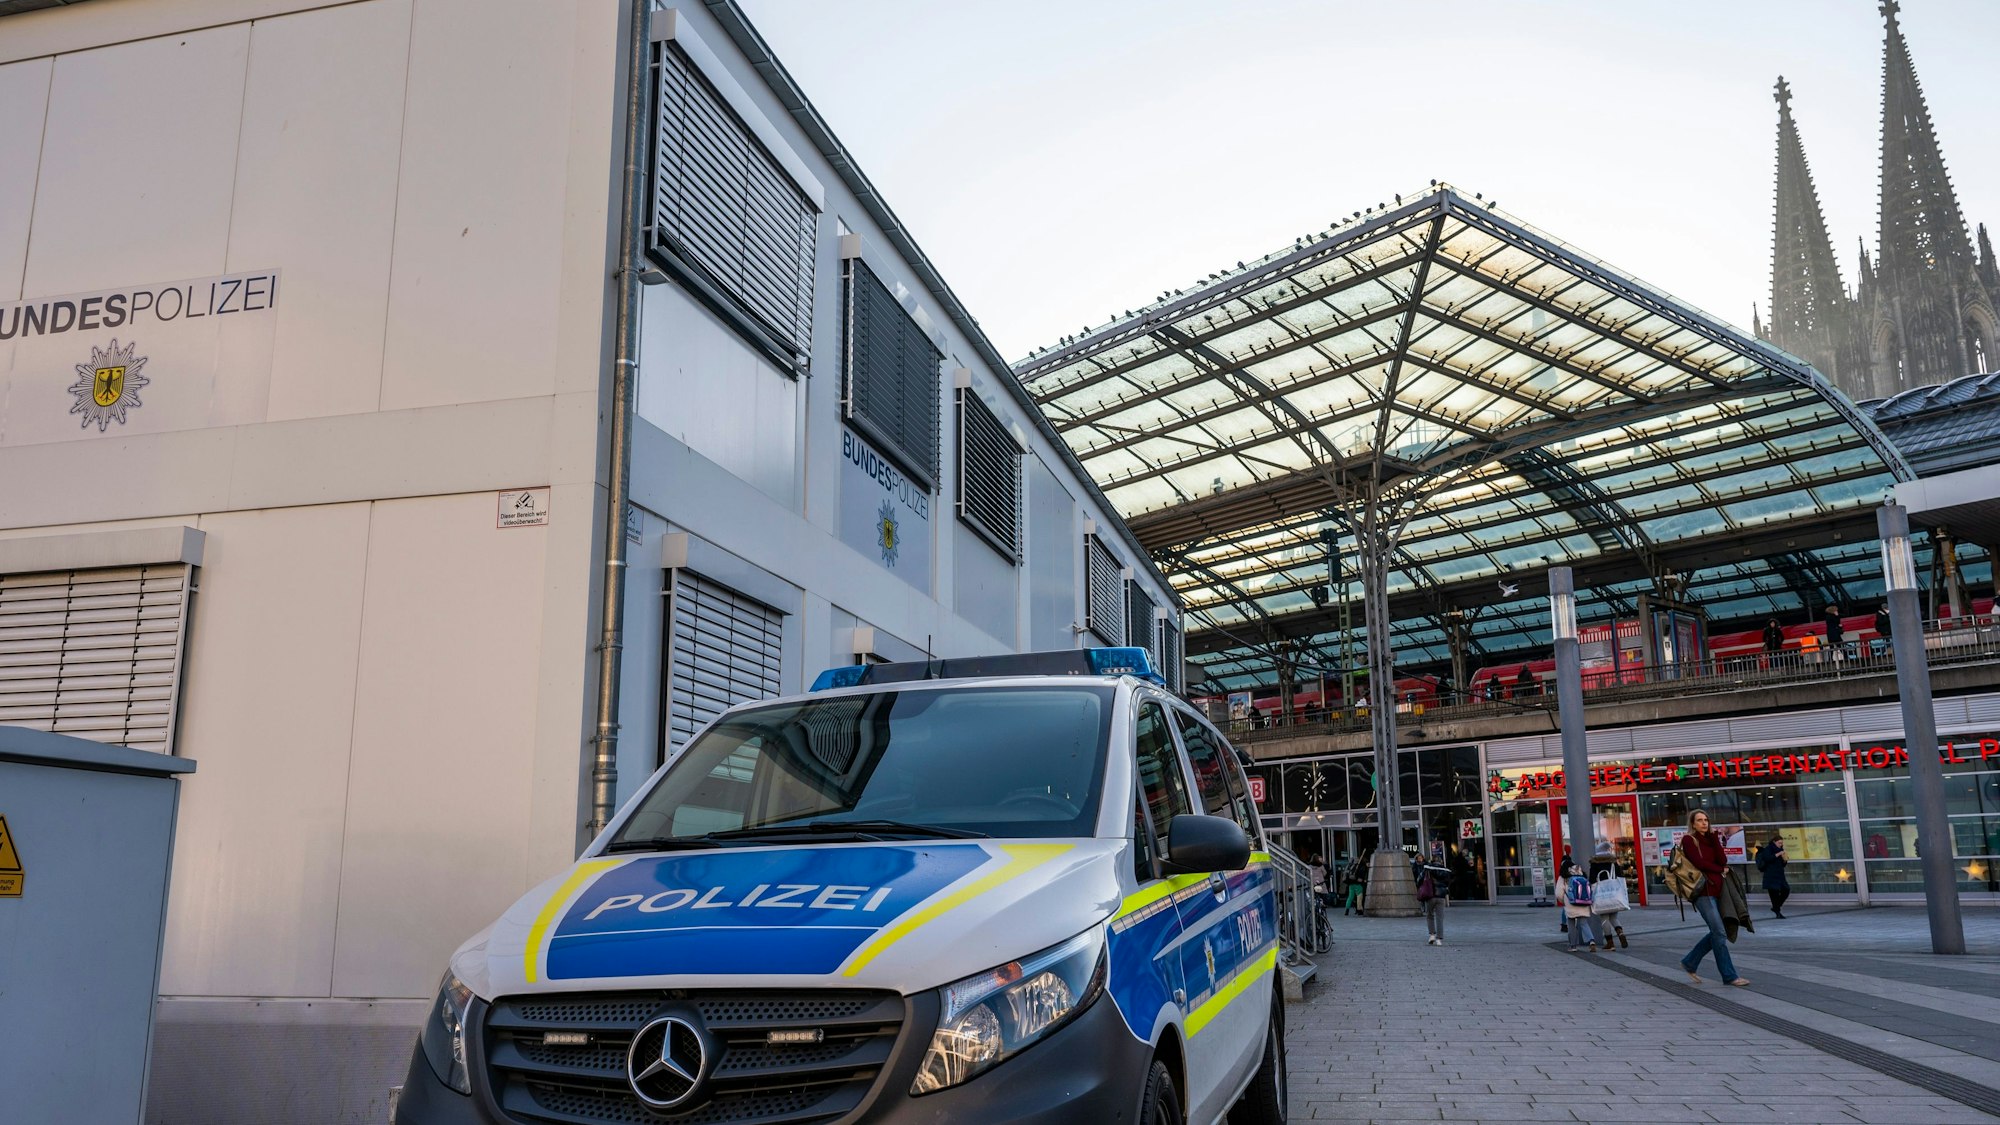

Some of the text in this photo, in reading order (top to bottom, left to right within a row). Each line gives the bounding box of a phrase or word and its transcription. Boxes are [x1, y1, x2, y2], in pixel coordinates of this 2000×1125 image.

[843, 430, 929, 522] BUNDESPOLIZEI
[1517, 764, 1654, 791] APOHEKE
[1698, 741, 1965, 780] INTERNATIONL
[582, 883, 893, 921] POLIZEI
[1236, 907, 1263, 958] POLIZEI
